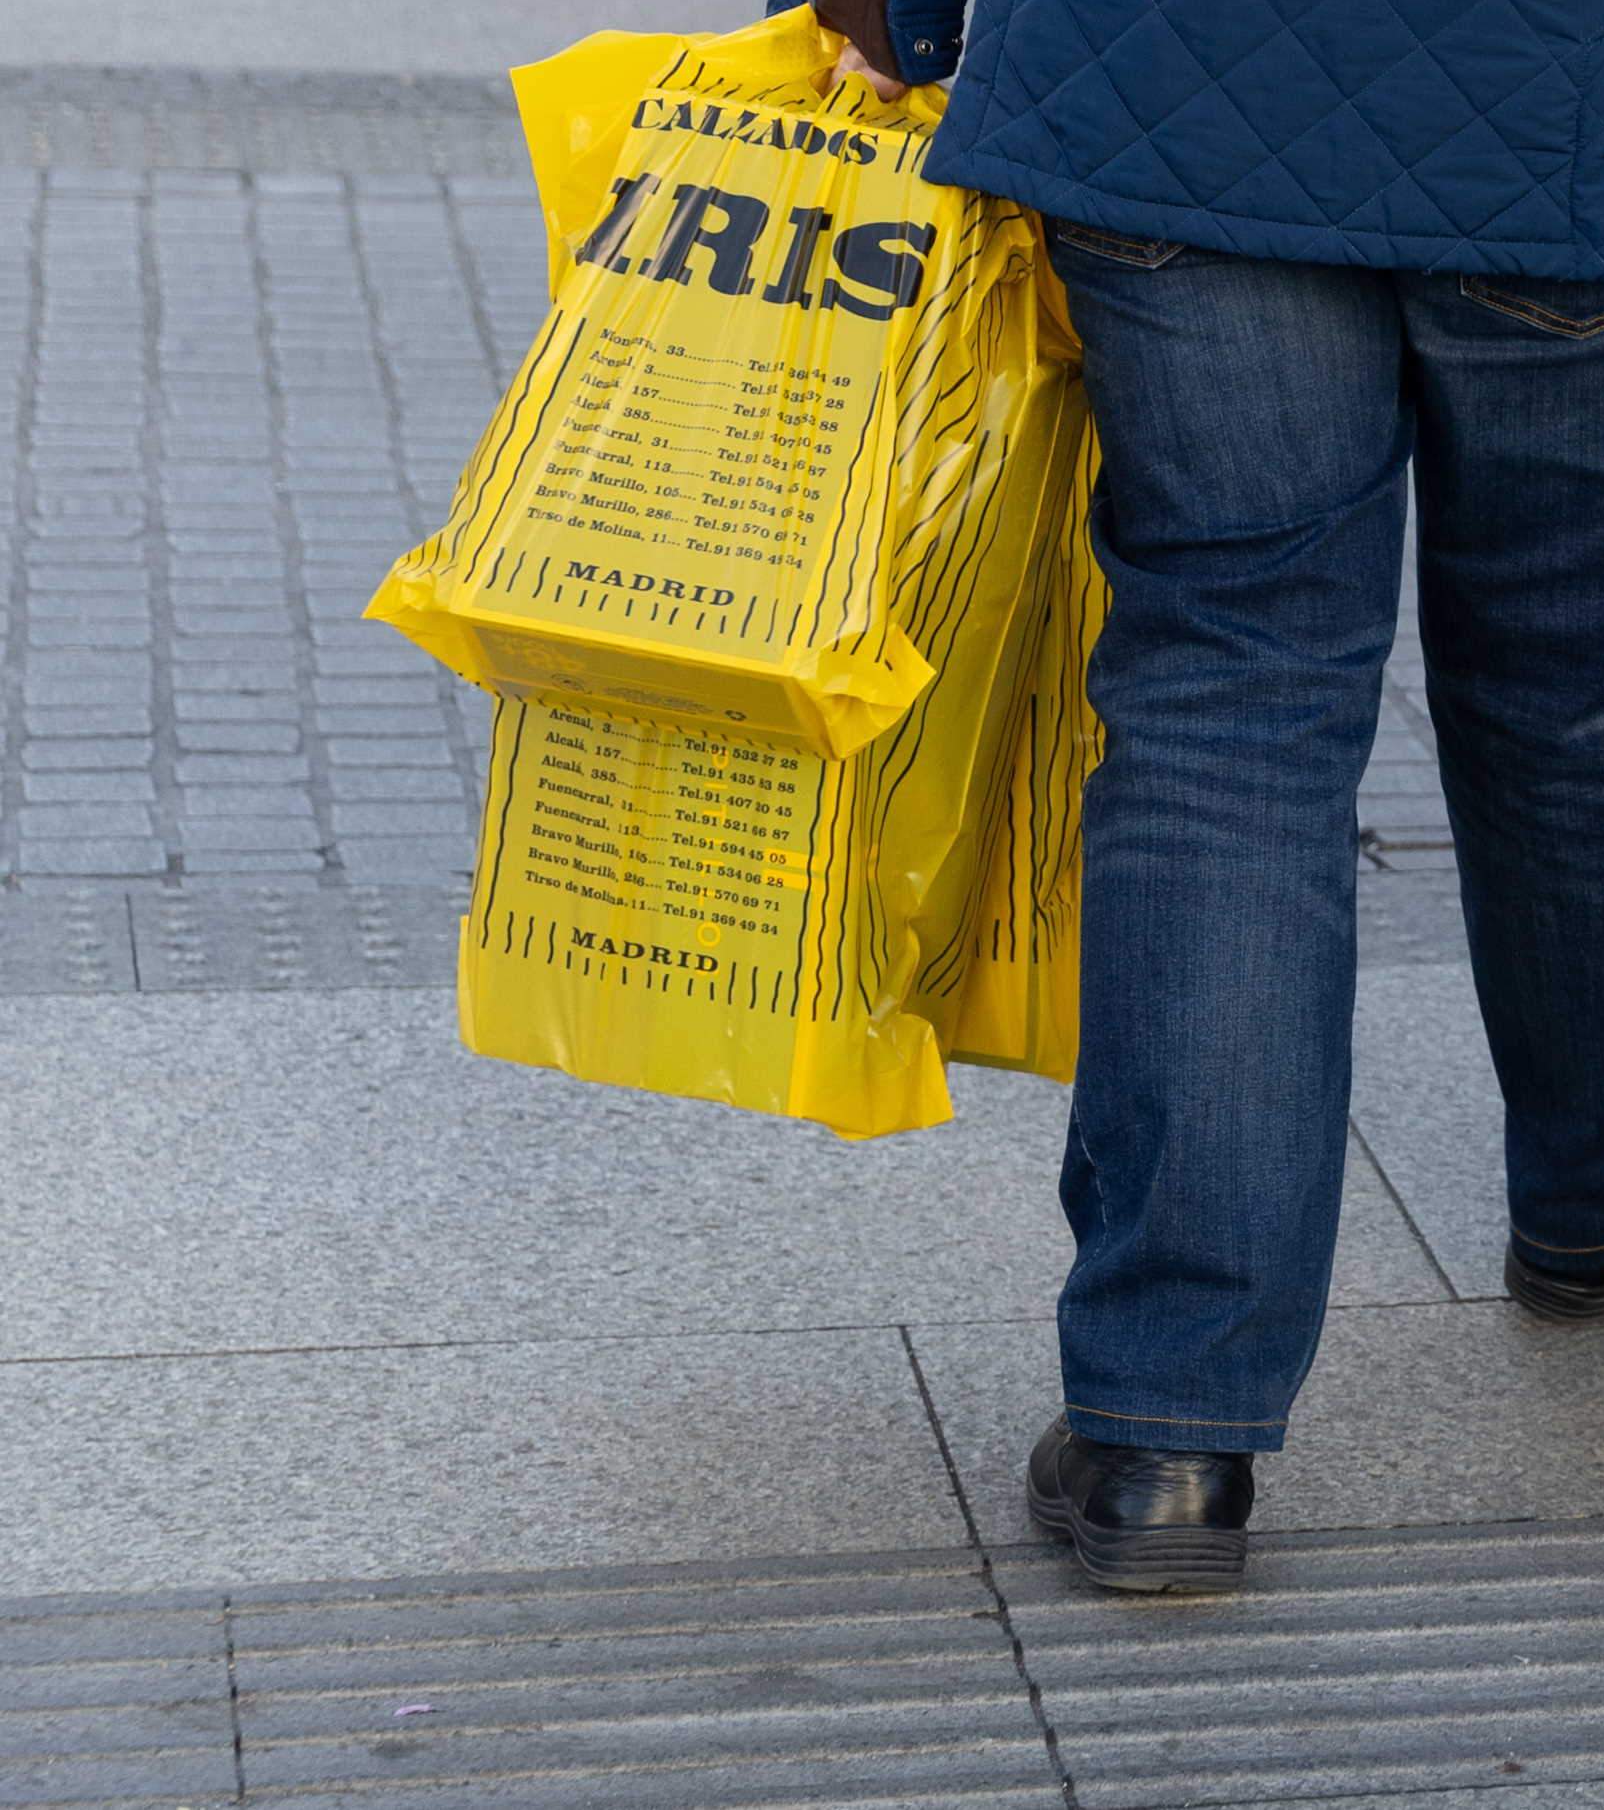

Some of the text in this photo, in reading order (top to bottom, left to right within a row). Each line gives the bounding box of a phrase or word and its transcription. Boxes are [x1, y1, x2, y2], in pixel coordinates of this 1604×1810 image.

[631, 97, 879, 165] CALZADOS
[575, 172, 937, 321] IRIS
[825, 398, 844, 410] 28
[832, 376, 851, 387] 49
[819, 420, 838, 432] 88
[756, 477, 783, 494] 594
[763, 454, 789, 472] 521
[791, 459, 806, 471] 6
[808, 465, 827, 478] 87
[742, 523, 770, 539] 570
[750, 500, 776, 517] 534
[568, 516, 585, 529] de
[736, 546, 763, 561] 369
[564, 561, 735, 607] MADRID
[545, 731, 587, 753] Alcalá,
[730, 772, 756, 786] 435
[777, 782, 795, 794] 88
[549, 708, 594, 731] Arenal,
[732, 748, 758, 763] 532
[780, 758, 798, 771] 28
[538, 777, 613, 808] Fuencarral,
[723, 818, 748, 833] 521
[772, 829, 790, 841] 87
[541, 754, 584, 776] Alcalá,
[726, 795, 752, 810] 407
[775, 805, 792, 818] 45
[531, 824, 572, 843] Bravo
[717, 866, 742, 880] 534
[766, 875, 784, 888] 28
[534, 800, 610, 831] Fuencarral,
[720, 842, 745, 856] 594
[769, 852, 786, 865] 05
[525, 870, 561, 888] Tirso
[711, 912, 735, 926] 369
[739, 919, 756, 932] 49
[761, 923, 778, 936] 34
[528, 847, 569, 866] Bravo
[714, 889, 739, 903] 570
[742, 896, 759, 908] 69
[764, 899, 780, 912] 71
[571, 927, 718, 972] MADRID
